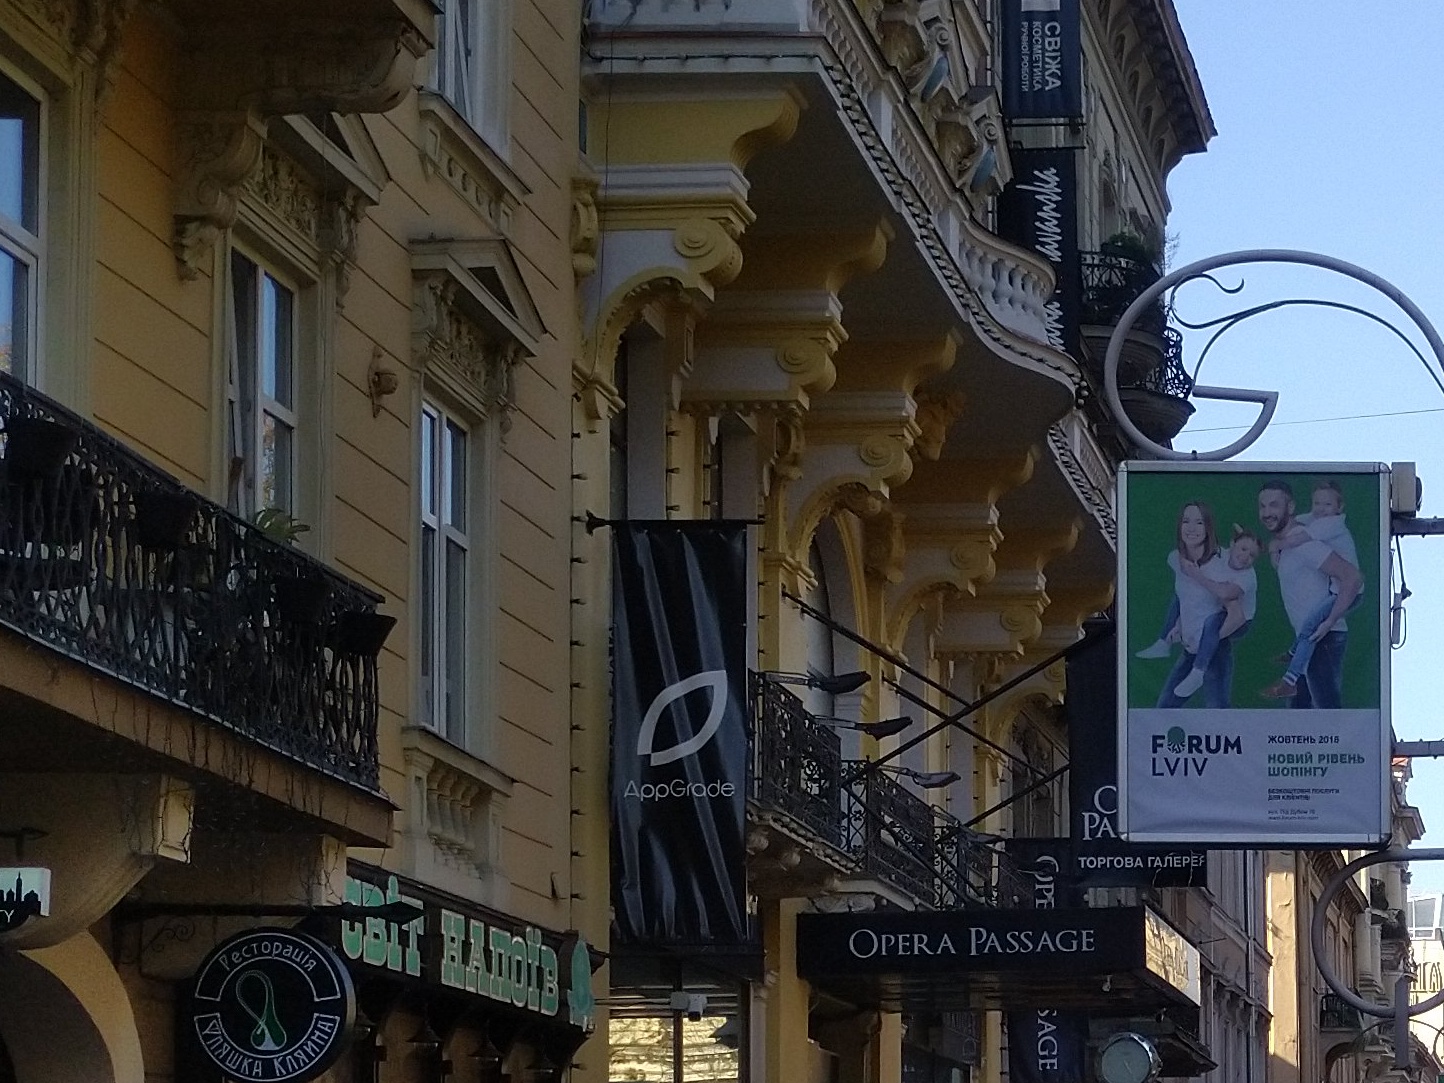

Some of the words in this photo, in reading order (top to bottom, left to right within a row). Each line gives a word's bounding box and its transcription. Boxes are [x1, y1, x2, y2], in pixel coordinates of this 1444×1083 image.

[1032, 20, 1042, 92] КОСМЕТИКА
[1044, 21, 1062, 91] СВІЖА
[1021, 55, 1029, 92] РОБОТИ
[1267, 735, 1316, 745] ЖОВТЕНЬ
[1151, 757, 1209, 777] LVIV
[1267, 751, 1314, 764] НОВИЙ
[1317, 753, 1366, 765] РІВЕНЬ
[1267, 766, 1329, 778] ШОПІНГУ
[623, 778, 736, 802] AppGrade
[1077, 856, 1144, 869] ТОРГОВА
[1034, 855, 1060, 909] OPE
[218, 941, 317, 972] Ресторація
[1037, 1008, 1059, 1072] SAGE
